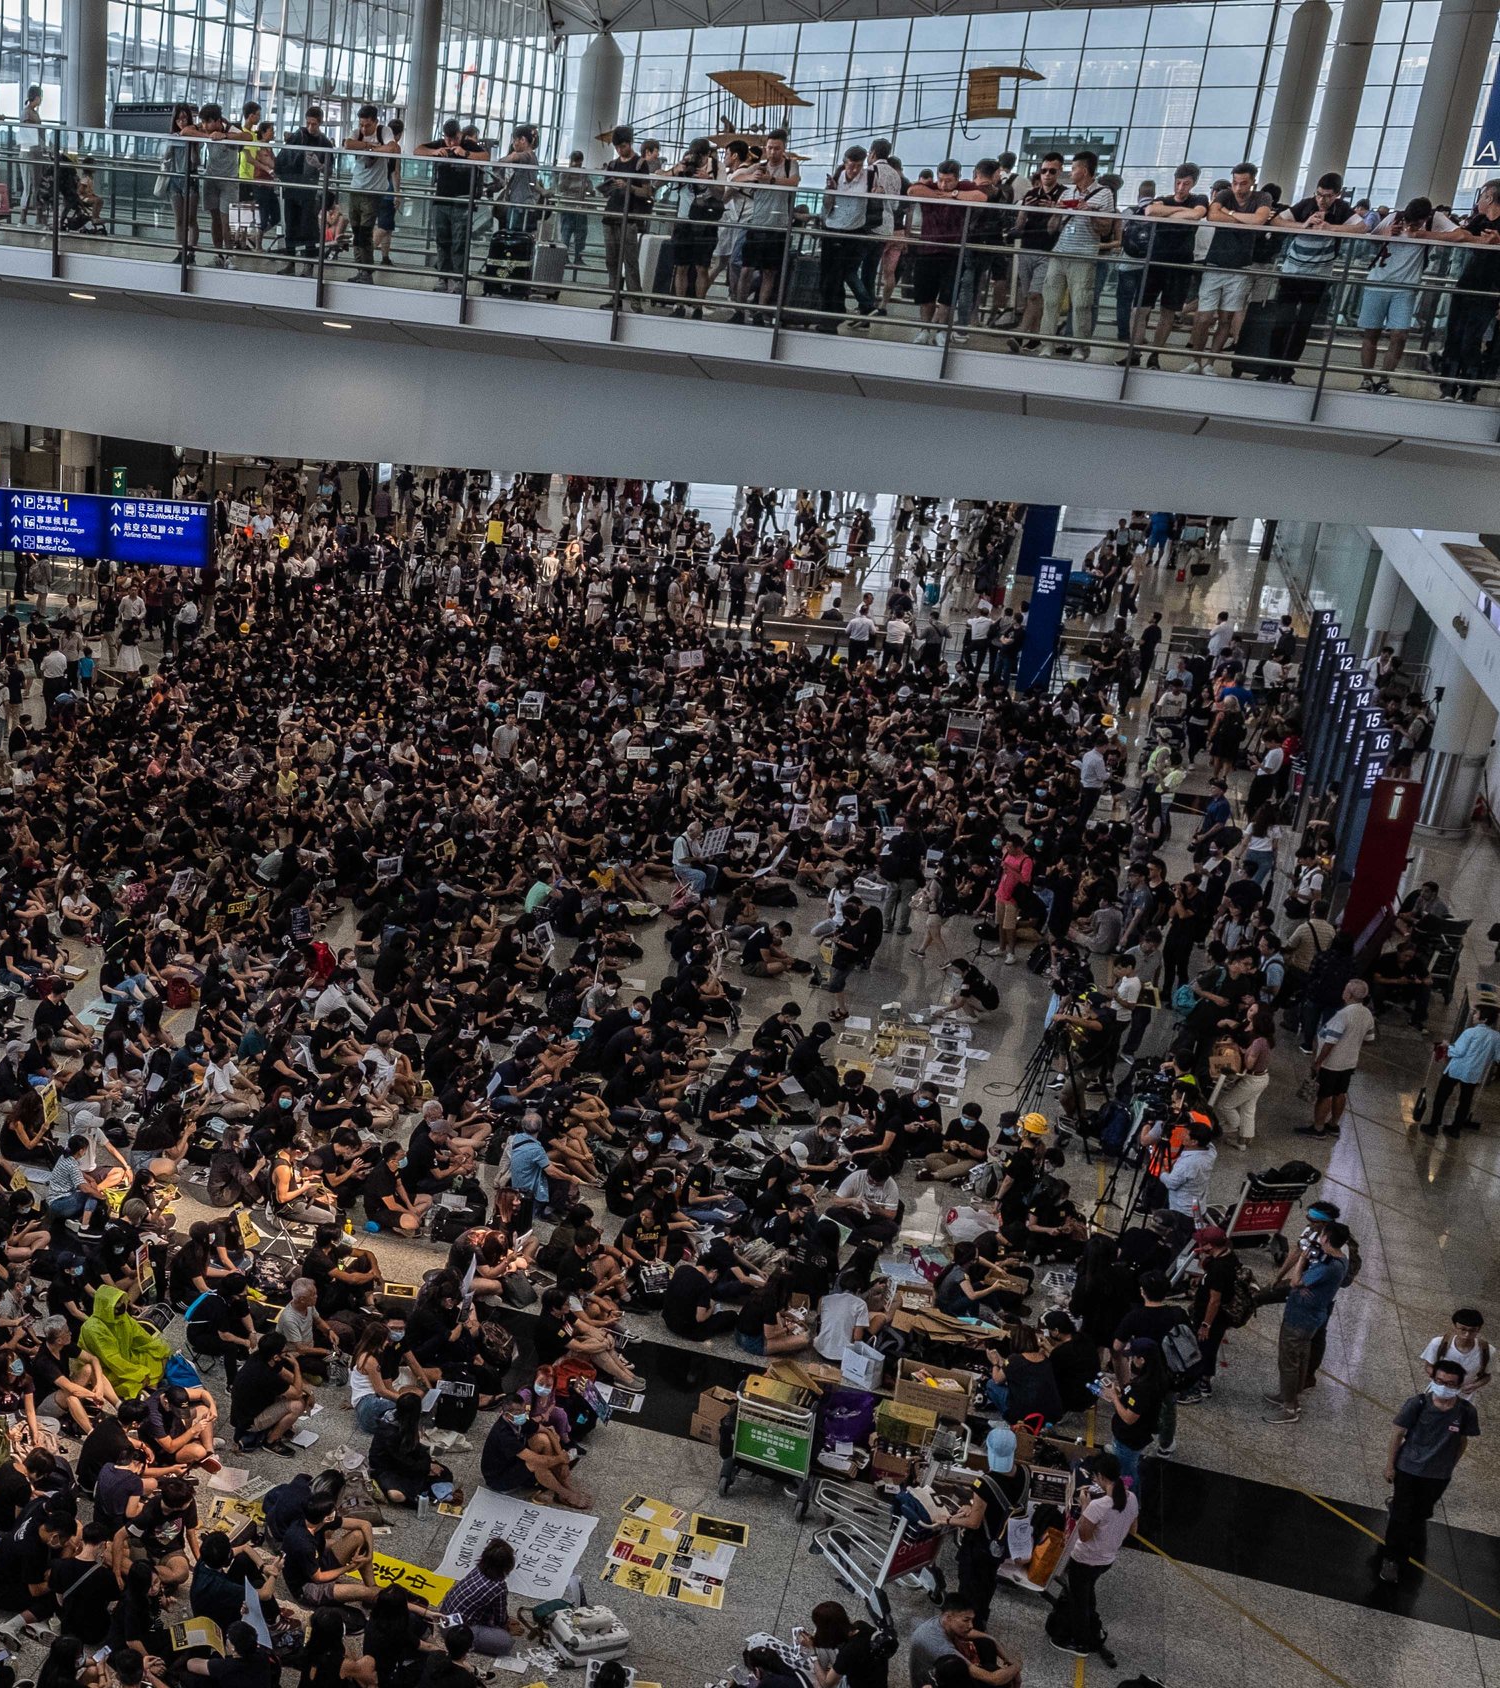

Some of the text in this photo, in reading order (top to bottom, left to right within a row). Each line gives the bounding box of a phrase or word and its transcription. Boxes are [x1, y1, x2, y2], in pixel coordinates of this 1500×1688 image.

[62, 498, 69, 512] 1
[36, 524, 85, 535] Limousine Lounge
[123, 531, 161, 540] Airline Offices
[36, 543, 76, 553] Medical Centre
[1322, 613, 1331, 624] 9
[1326, 626, 1339, 639] 10
[1335, 641, 1347, 654] 11
[1339, 657, 1353, 670] 12
[1349, 674, 1363, 688] 13
[1356, 692, 1370, 706] 14
[1366, 712, 1381, 728] 15
[1375, 734, 1391, 750] 16
[506, 1508, 540, 1546] FIGHTING
[455, 1519, 487, 1569] SORRY FOR THE
[516, 1521, 563, 1573] THE FUTURE
[532, 1526, 583, 1587] OF OUR HOME
